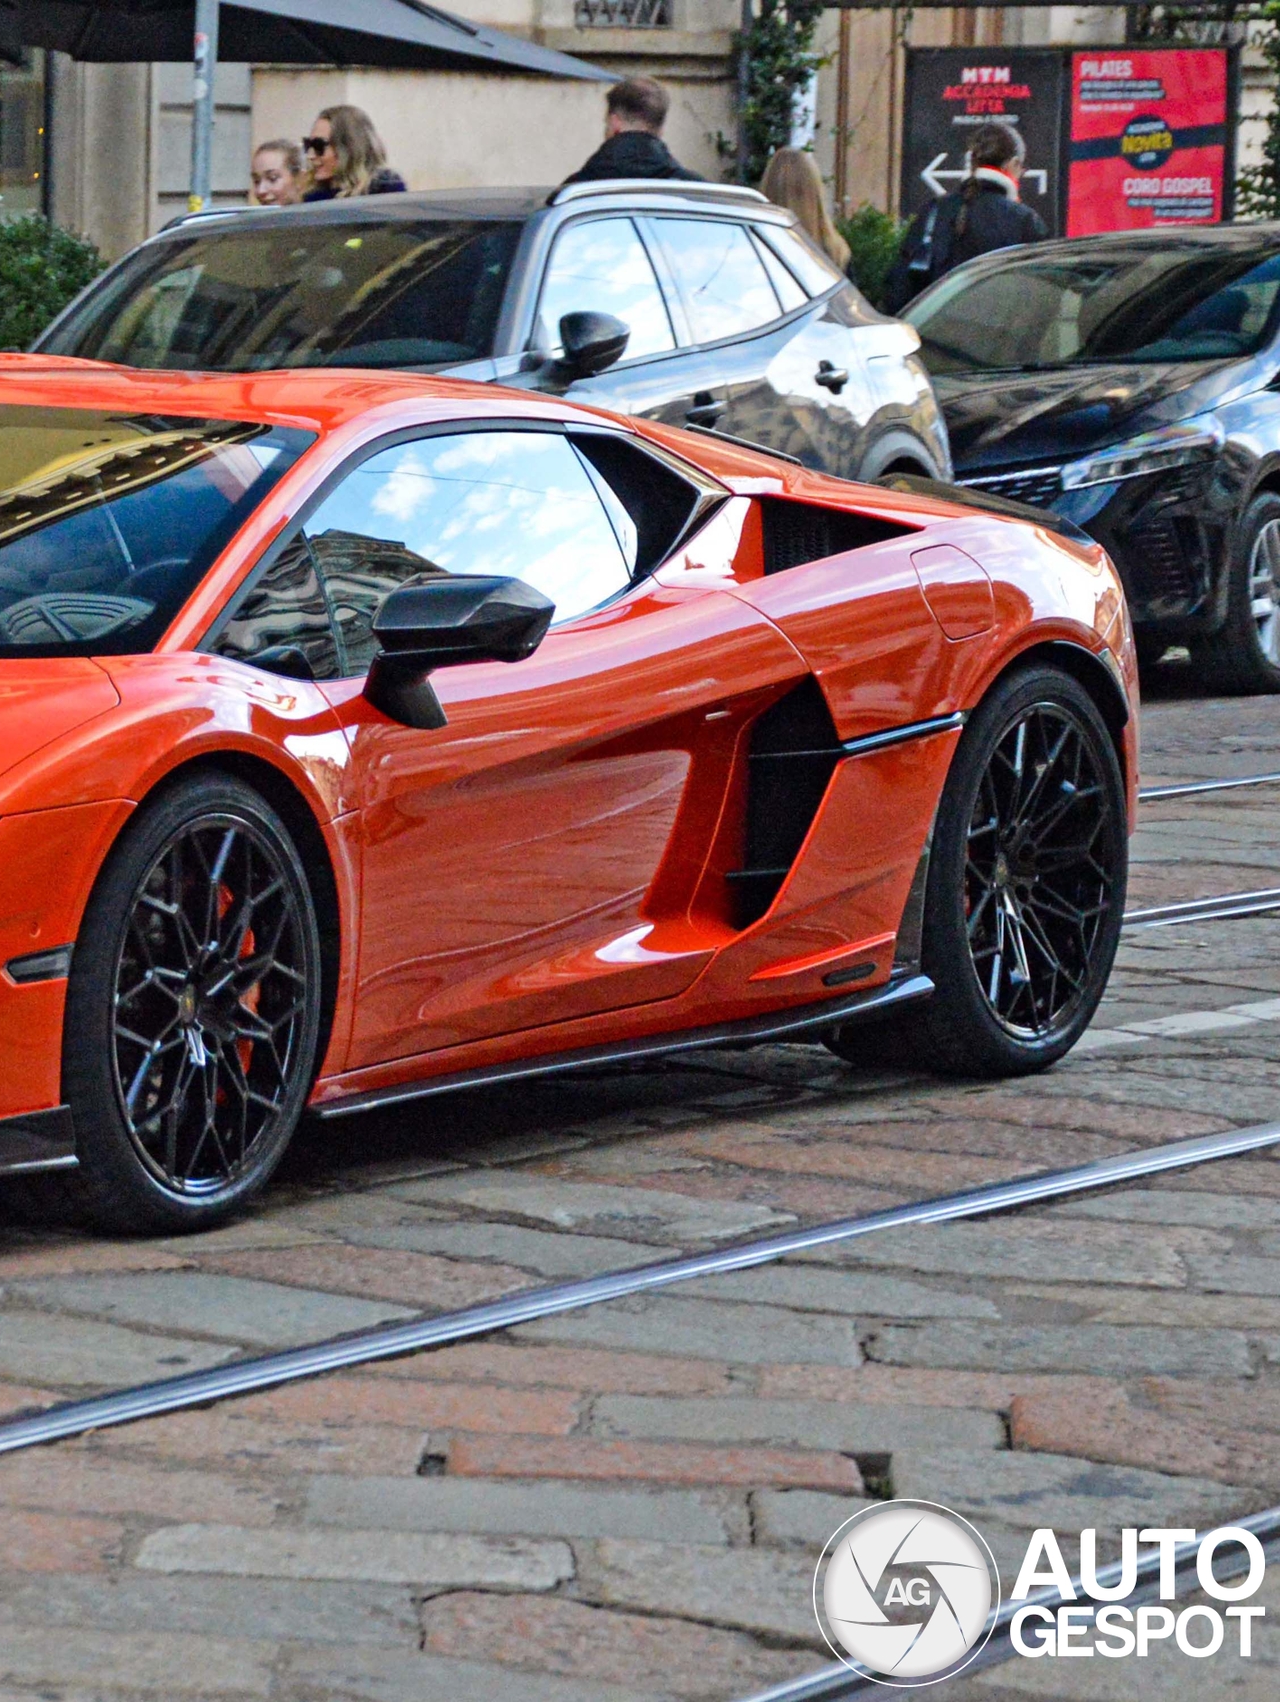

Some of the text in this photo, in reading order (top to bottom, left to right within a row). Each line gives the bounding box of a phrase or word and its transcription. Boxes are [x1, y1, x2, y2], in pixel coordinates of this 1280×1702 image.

[962, 67, 1010, 83] MTM
[1081, 60, 1133, 78] PILATES
[1123, 177, 1213, 195] CORO GOSPEL
